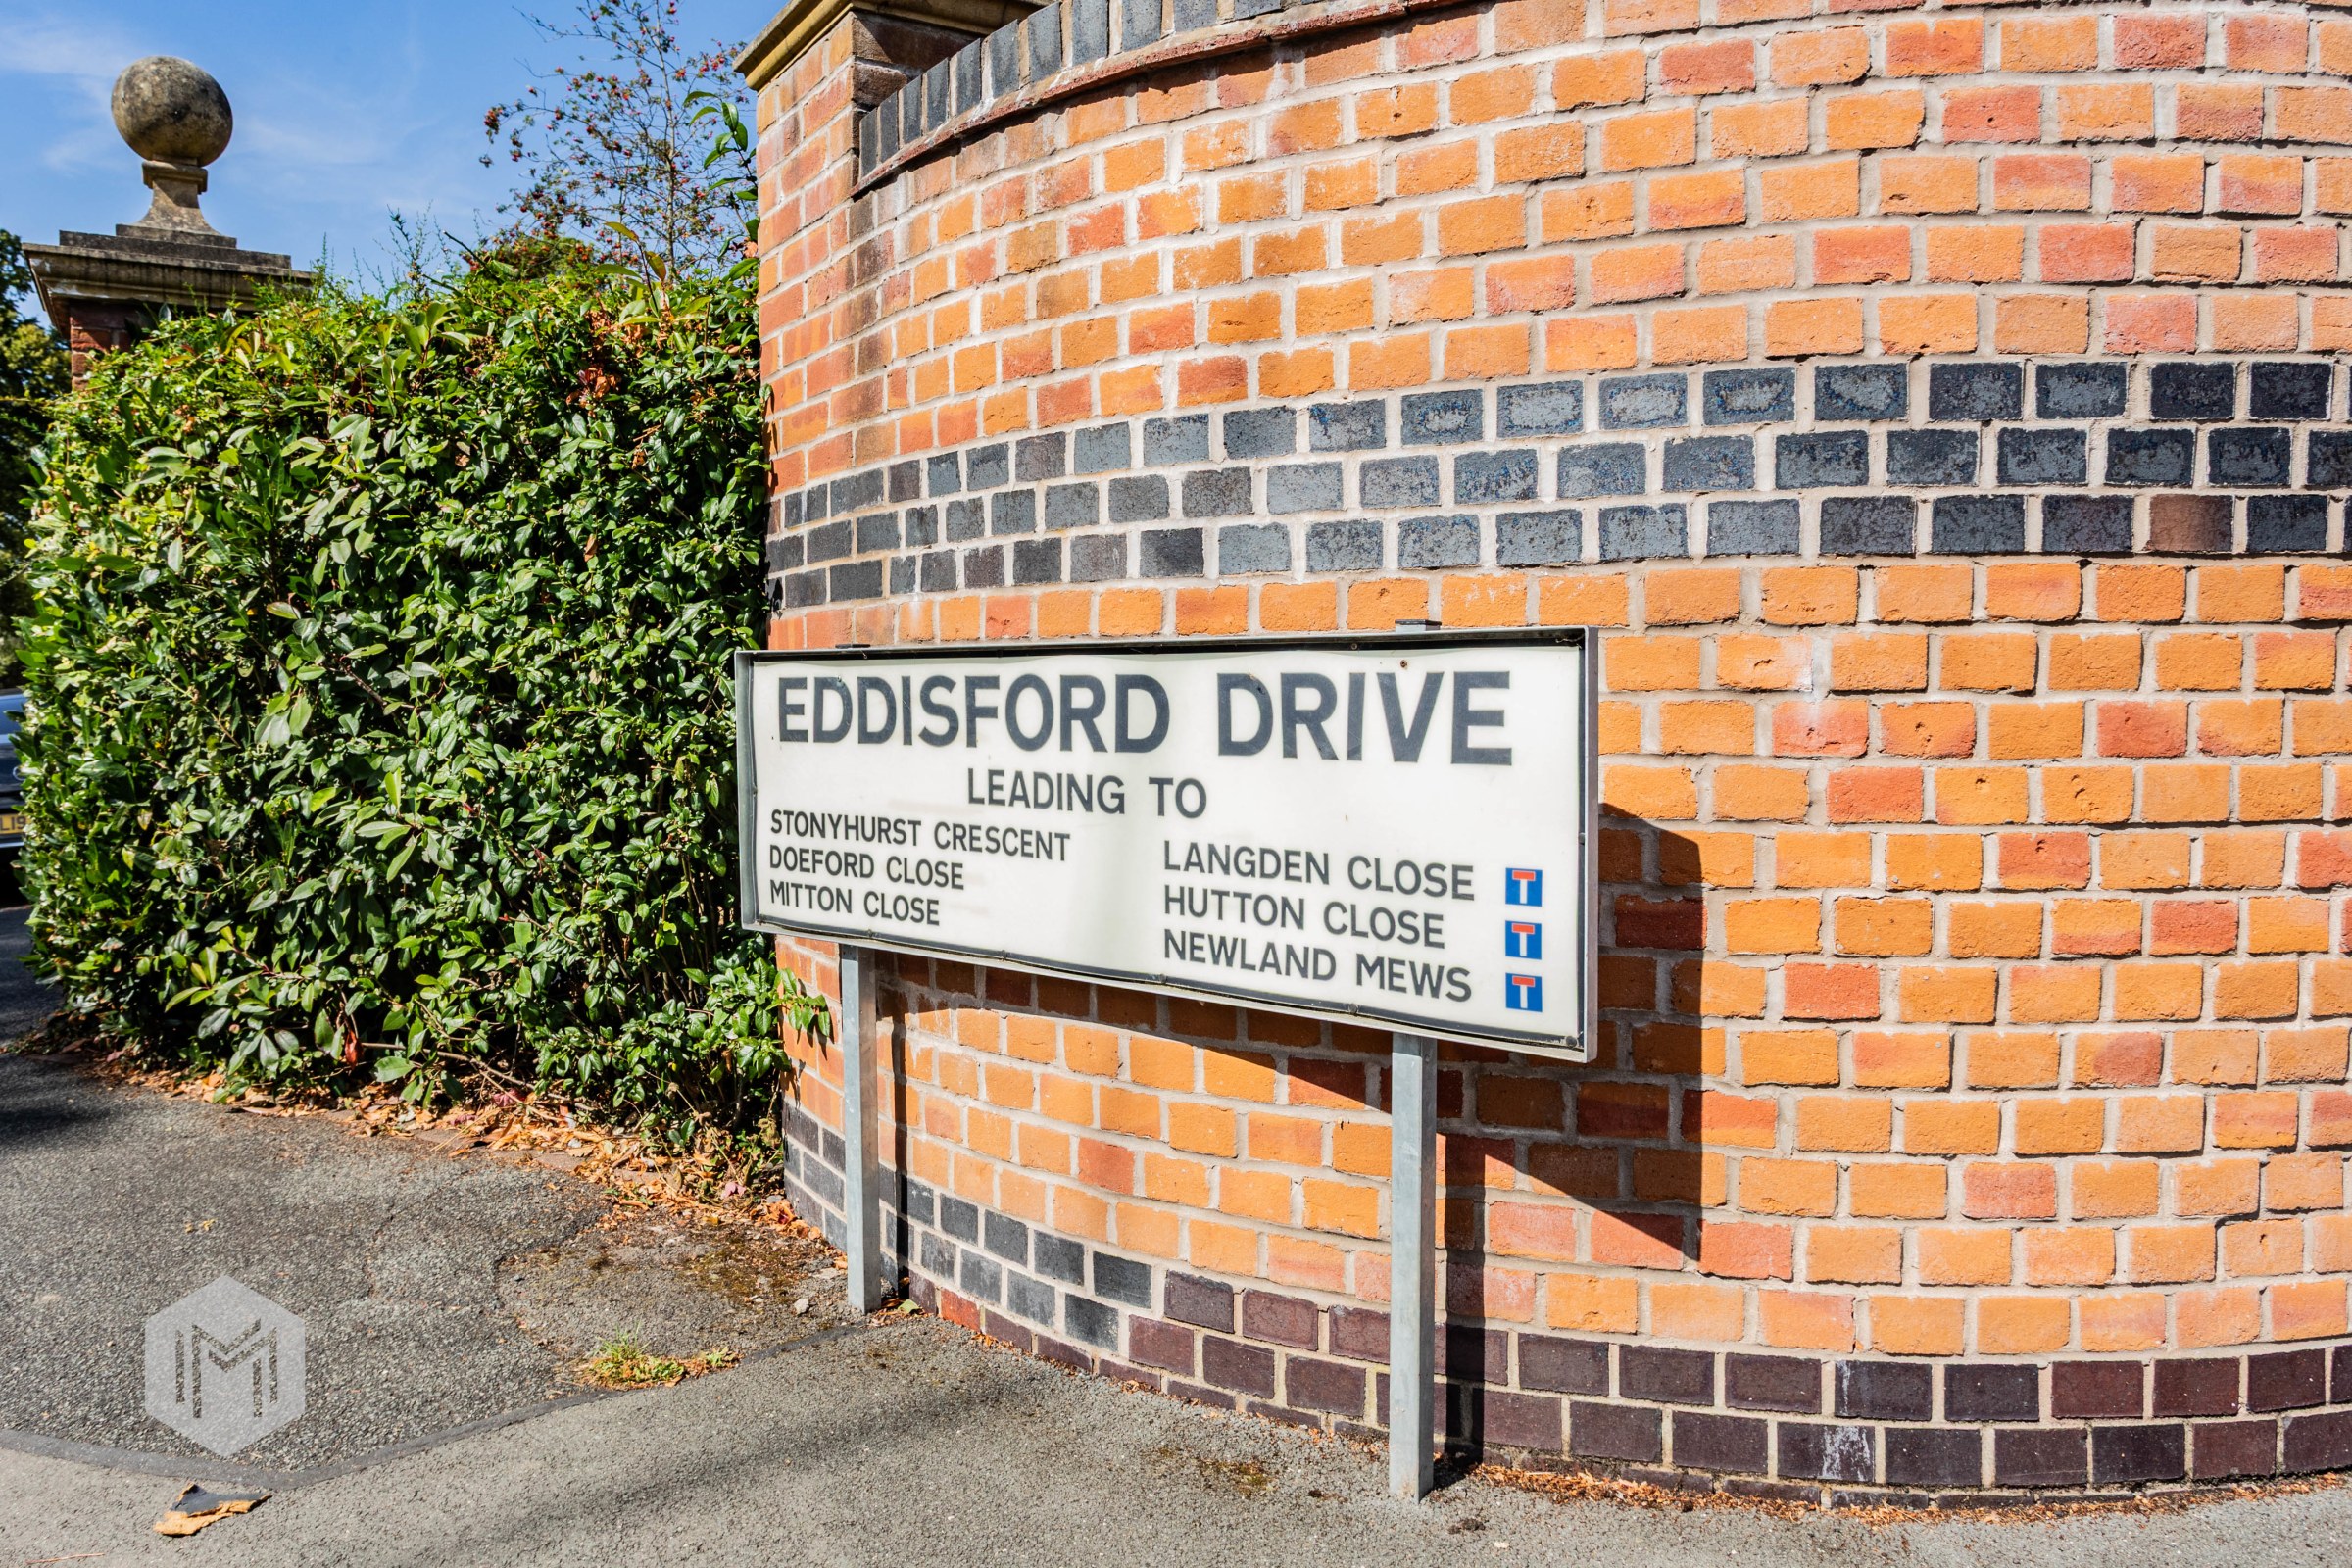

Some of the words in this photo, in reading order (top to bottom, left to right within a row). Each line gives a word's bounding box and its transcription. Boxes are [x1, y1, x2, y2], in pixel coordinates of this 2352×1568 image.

[778, 674, 1170, 754] EDDISFORD
[1217, 671, 1512, 766] DRIVE
[967, 767, 1125, 815] LEADING
[1148, 776, 1207, 819] TO
[770, 808, 922, 847] STONYHURST
[934, 821, 1071, 861] CRESCENT
[769, 844, 875, 879] DOEFORD
[886, 856, 965, 892] CLOSE
[1164, 840, 1330, 885] LANGDEN
[1348, 855, 1475, 901] CLOSE
[769, 879, 853, 914] MITTON
[863, 890, 940, 926] CLOSE
[1164, 884, 1304, 930] HUTTON
[1323, 901, 1446, 950] CLOSE
[1164, 928, 1337, 981] NEWLAND
[1356, 953, 1472, 1003] MEWS
